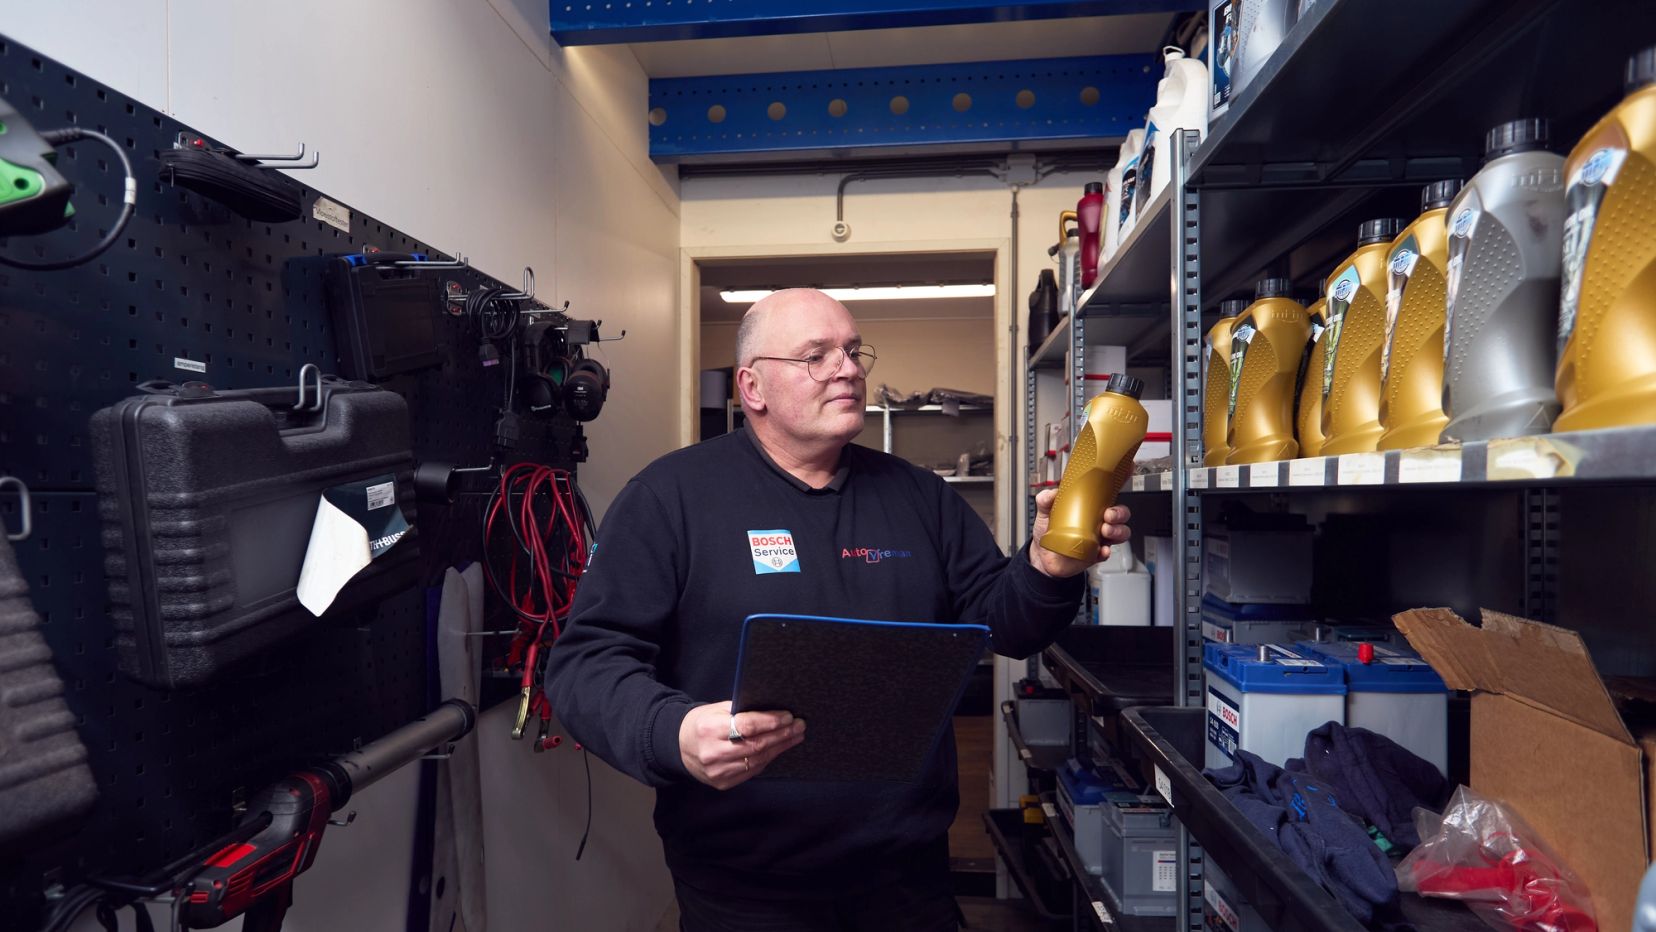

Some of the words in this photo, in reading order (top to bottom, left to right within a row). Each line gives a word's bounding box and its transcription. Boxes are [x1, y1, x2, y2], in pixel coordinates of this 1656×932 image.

[751, 536, 792, 547] BOSCH
[754, 547, 795, 557] Service
[1222, 706, 1238, 727] BOSCH
